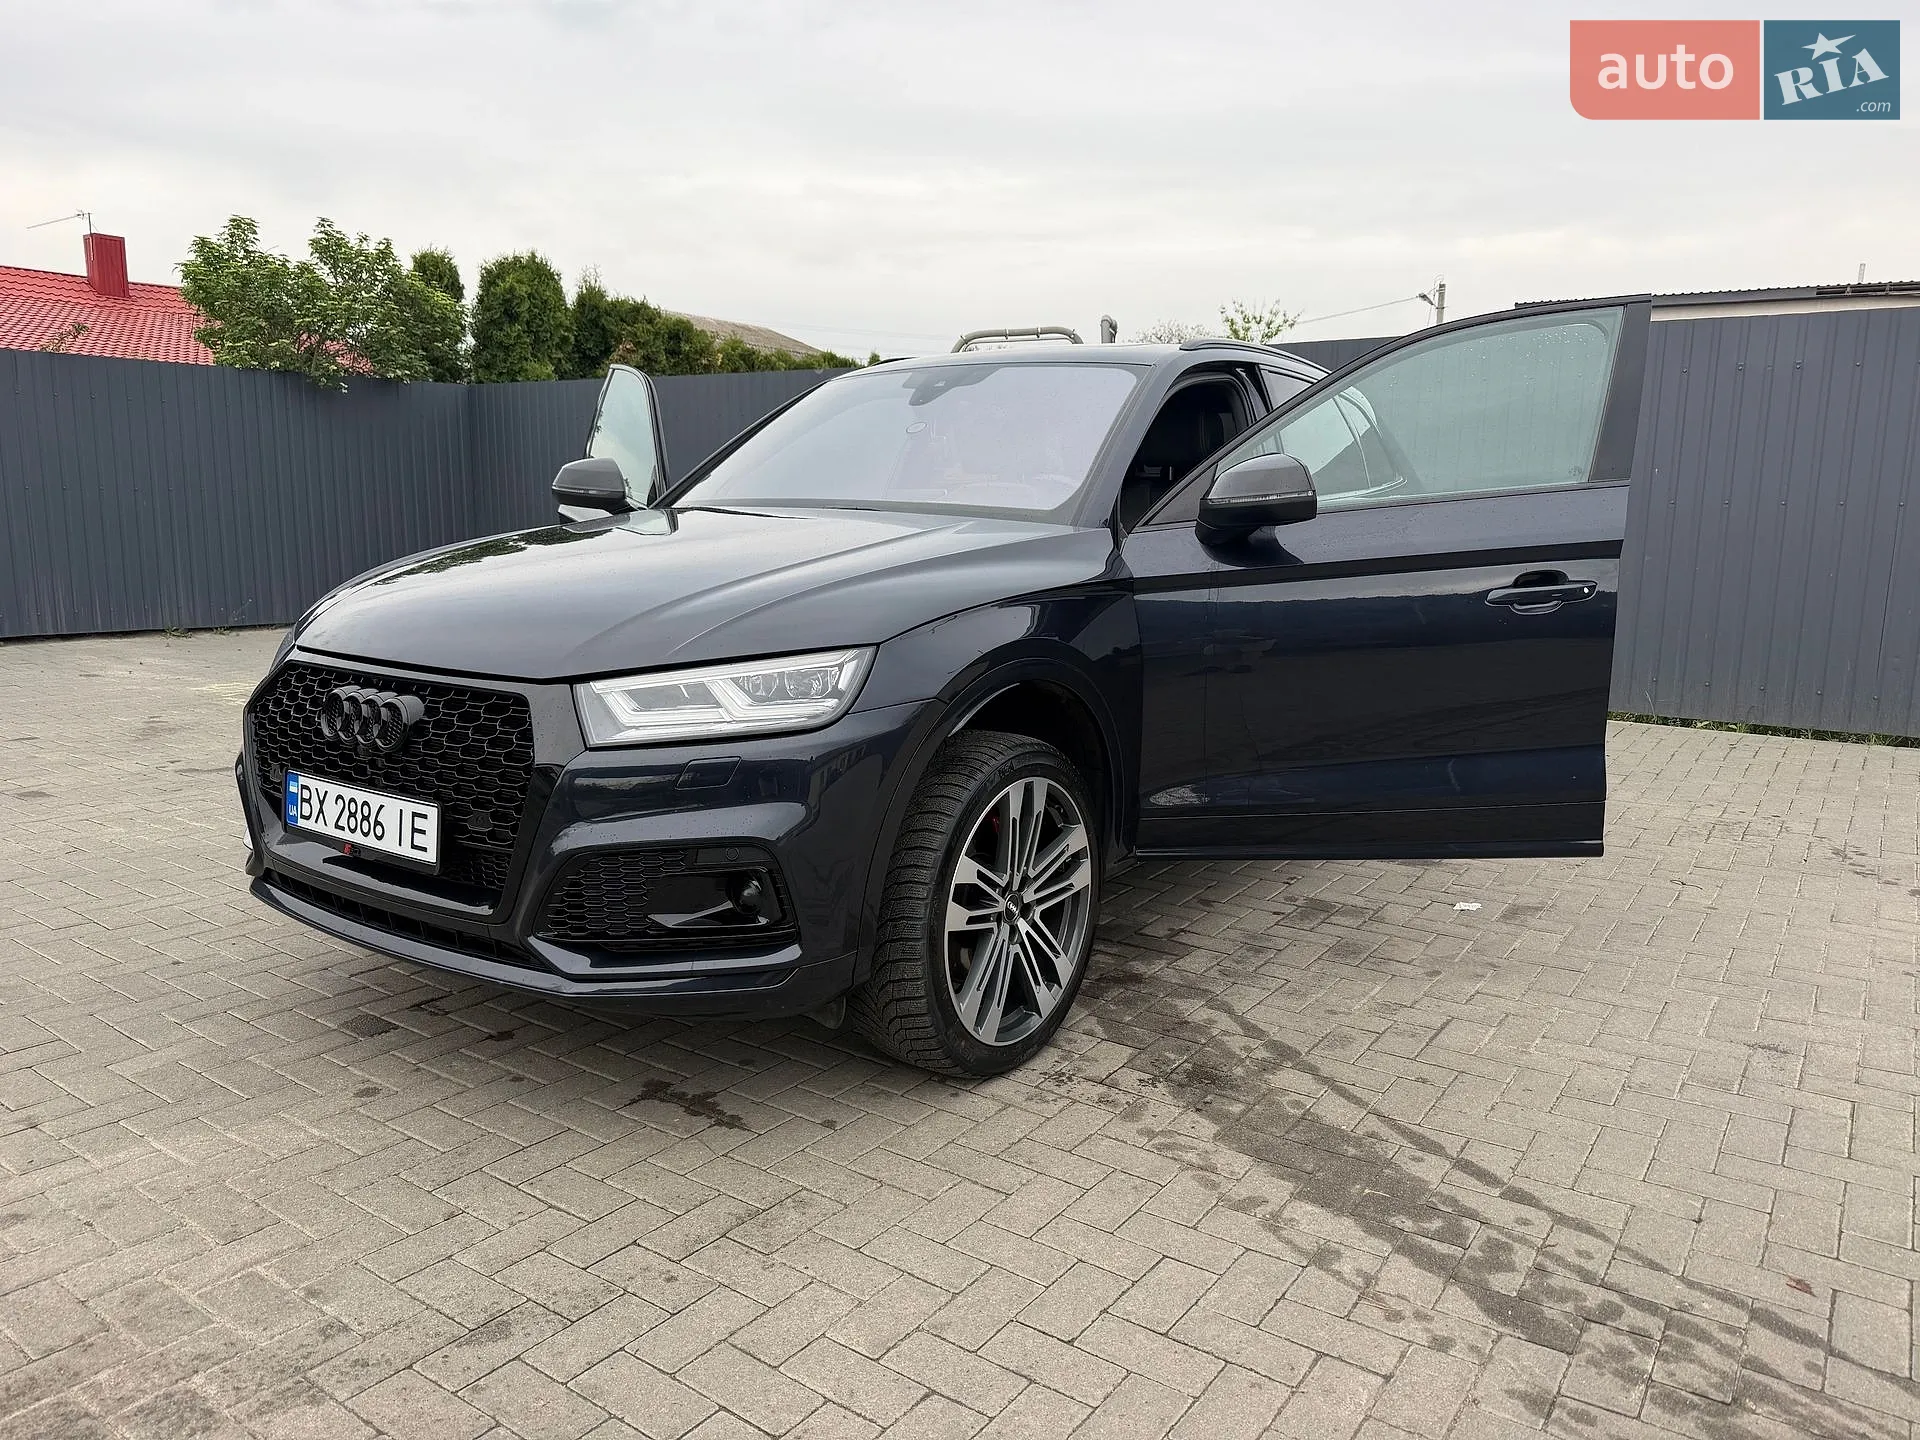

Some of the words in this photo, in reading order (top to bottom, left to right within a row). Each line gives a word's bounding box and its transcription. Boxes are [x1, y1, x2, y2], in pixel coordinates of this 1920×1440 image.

[288, 804, 297, 817] UA
[300, 784, 328, 827] BX
[334, 794, 386, 841] 2886
[398, 808, 428, 852] IE
